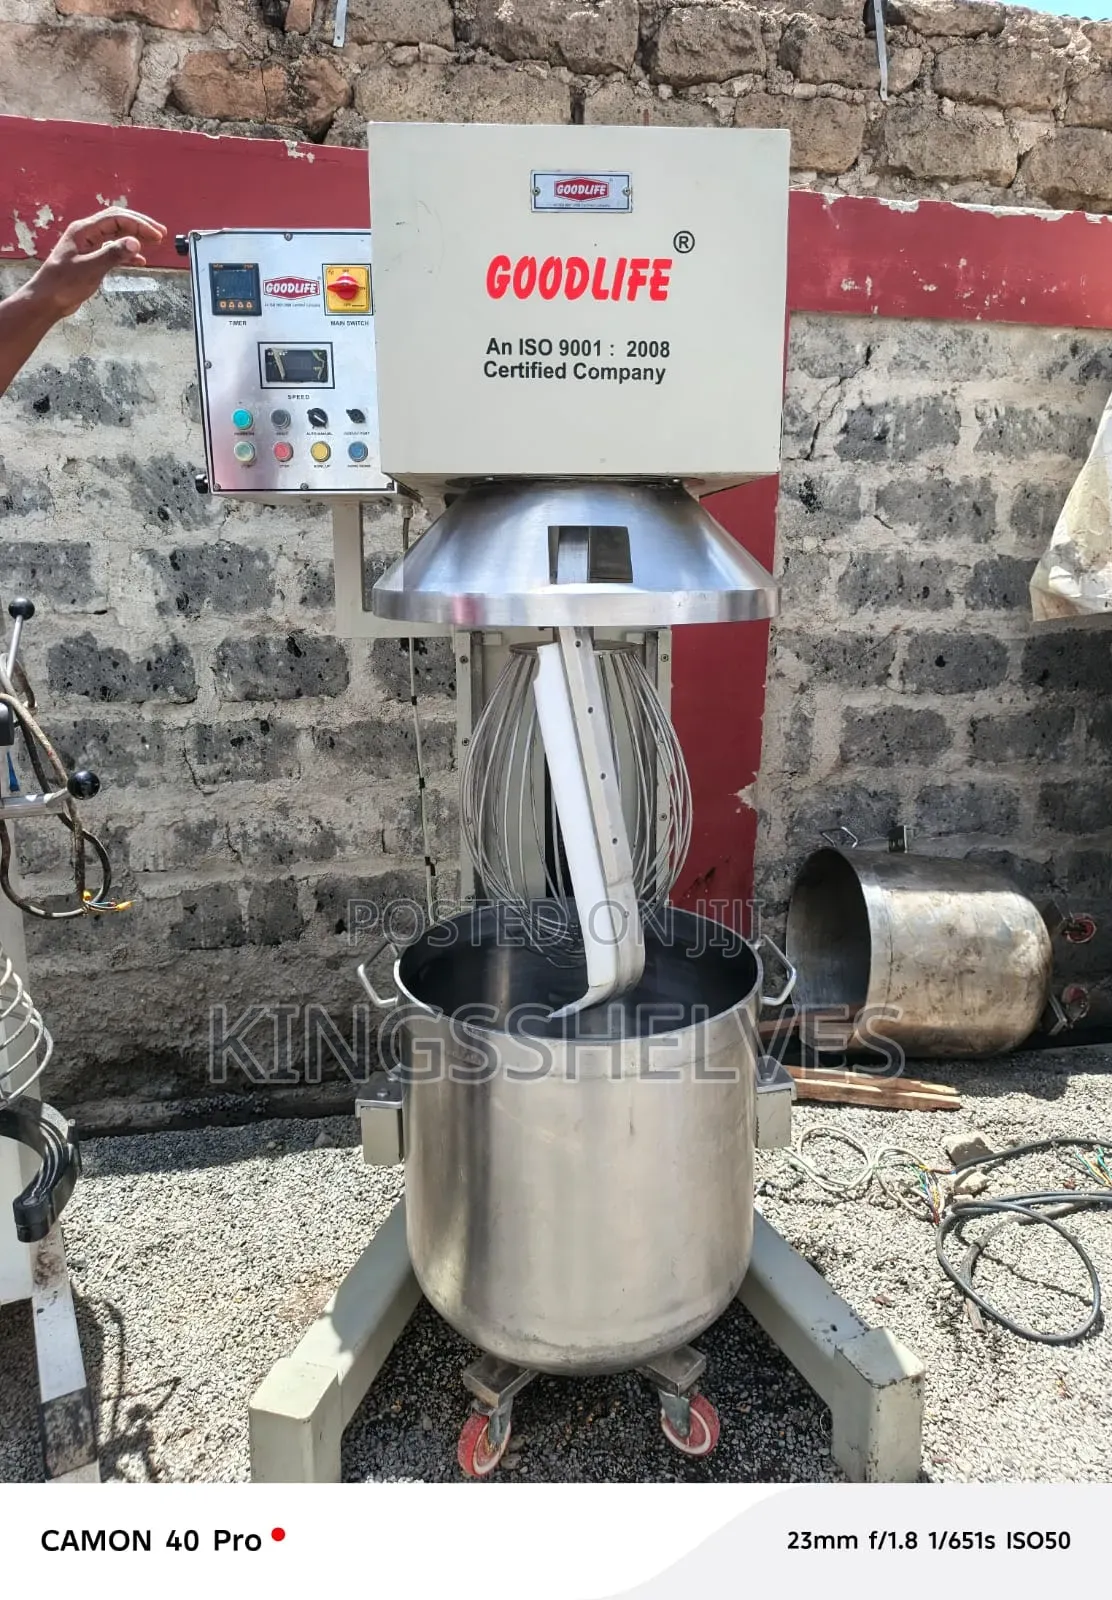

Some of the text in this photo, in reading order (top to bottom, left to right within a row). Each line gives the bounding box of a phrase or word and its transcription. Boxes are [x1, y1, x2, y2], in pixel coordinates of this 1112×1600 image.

[557, 184, 607, 195] GOODLIFE
[265, 282, 318, 294] GOODLIFE
[485, 254, 673, 302] GOODLIFE
[485, 337, 513, 356] An
[518, 338, 553, 357] ISO
[558, 339, 601, 357] 9001
[626, 340, 671, 358] 2008
[483, 360, 666, 385] Certified Company
